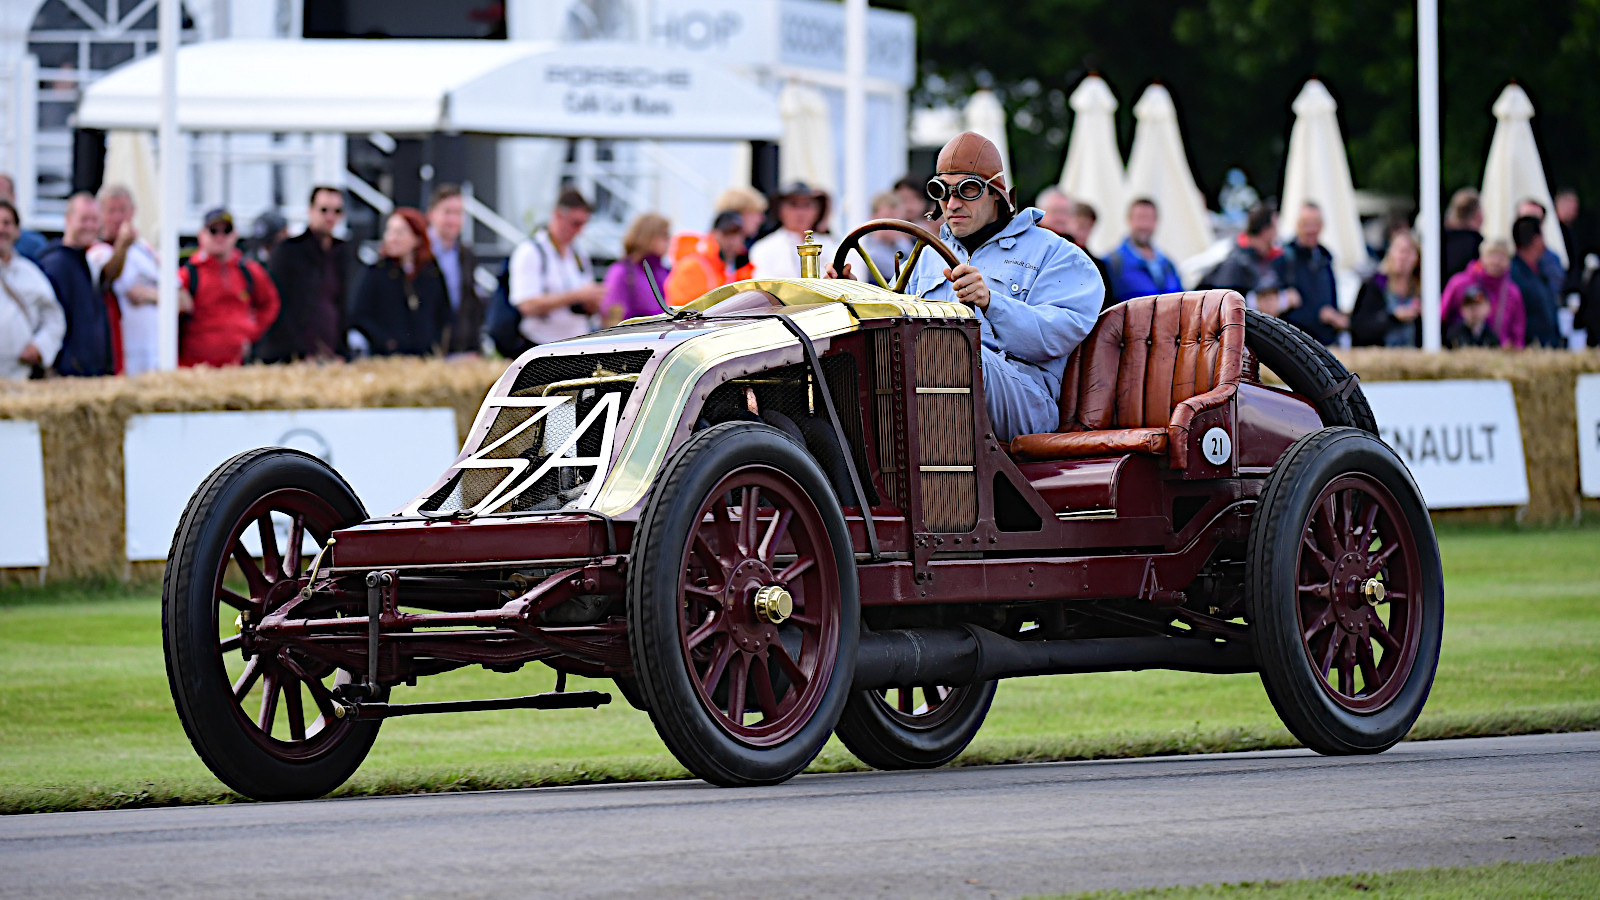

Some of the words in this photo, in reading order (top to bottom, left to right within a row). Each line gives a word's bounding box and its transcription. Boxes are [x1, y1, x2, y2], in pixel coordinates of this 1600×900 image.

[545, 66, 691, 88] PORSCHE
[1211, 437, 1223, 455] 21
[1380, 425, 1498, 463] NAULT
